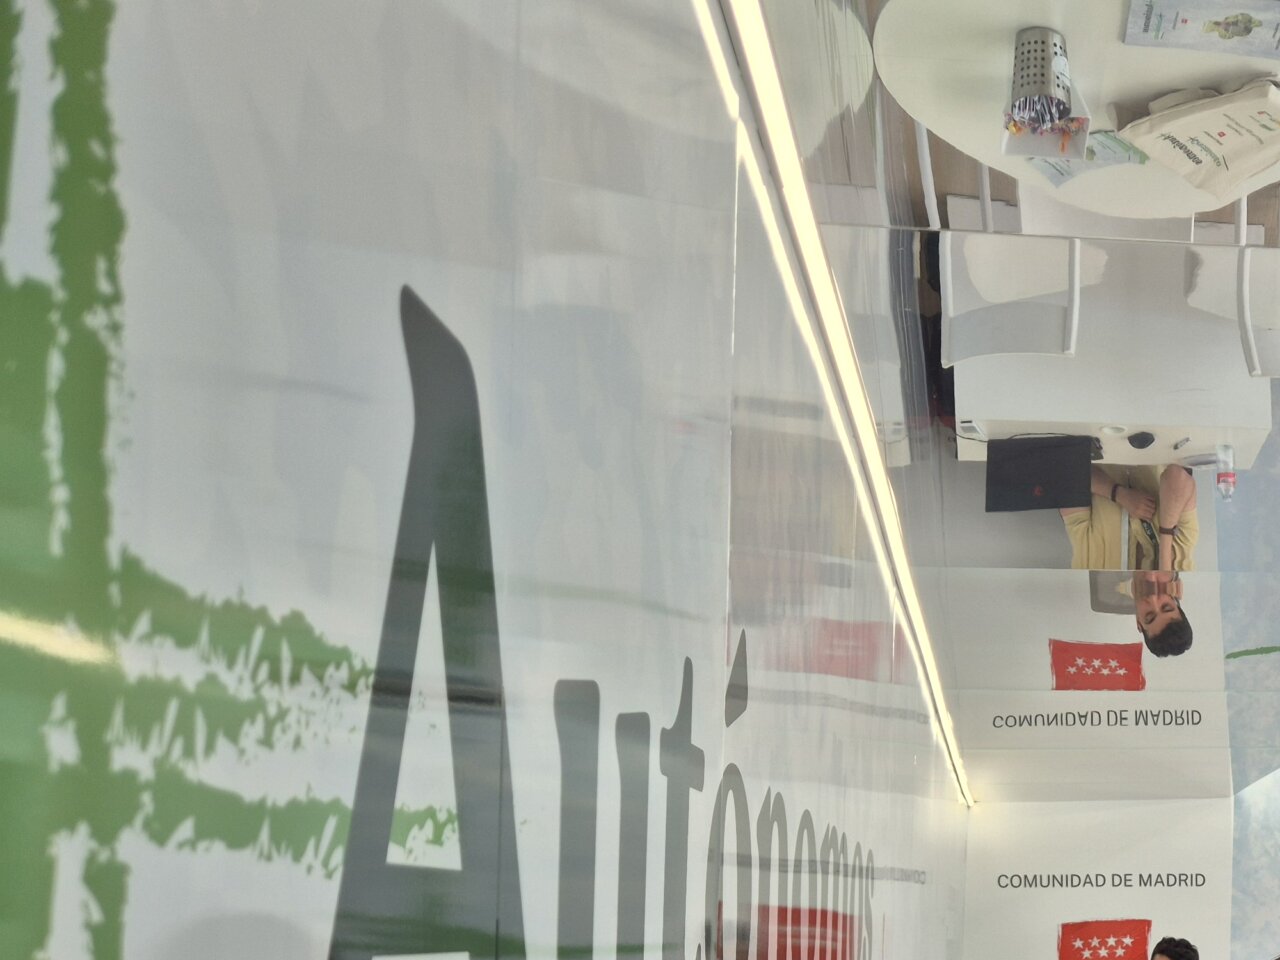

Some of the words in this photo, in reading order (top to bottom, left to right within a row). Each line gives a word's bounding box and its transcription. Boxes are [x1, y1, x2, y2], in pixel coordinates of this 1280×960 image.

[997, 874, 1106, 888] COMUNIDAD
[1111, 873, 1133, 887] DE
[1138, 873, 1206, 887] MADRID
